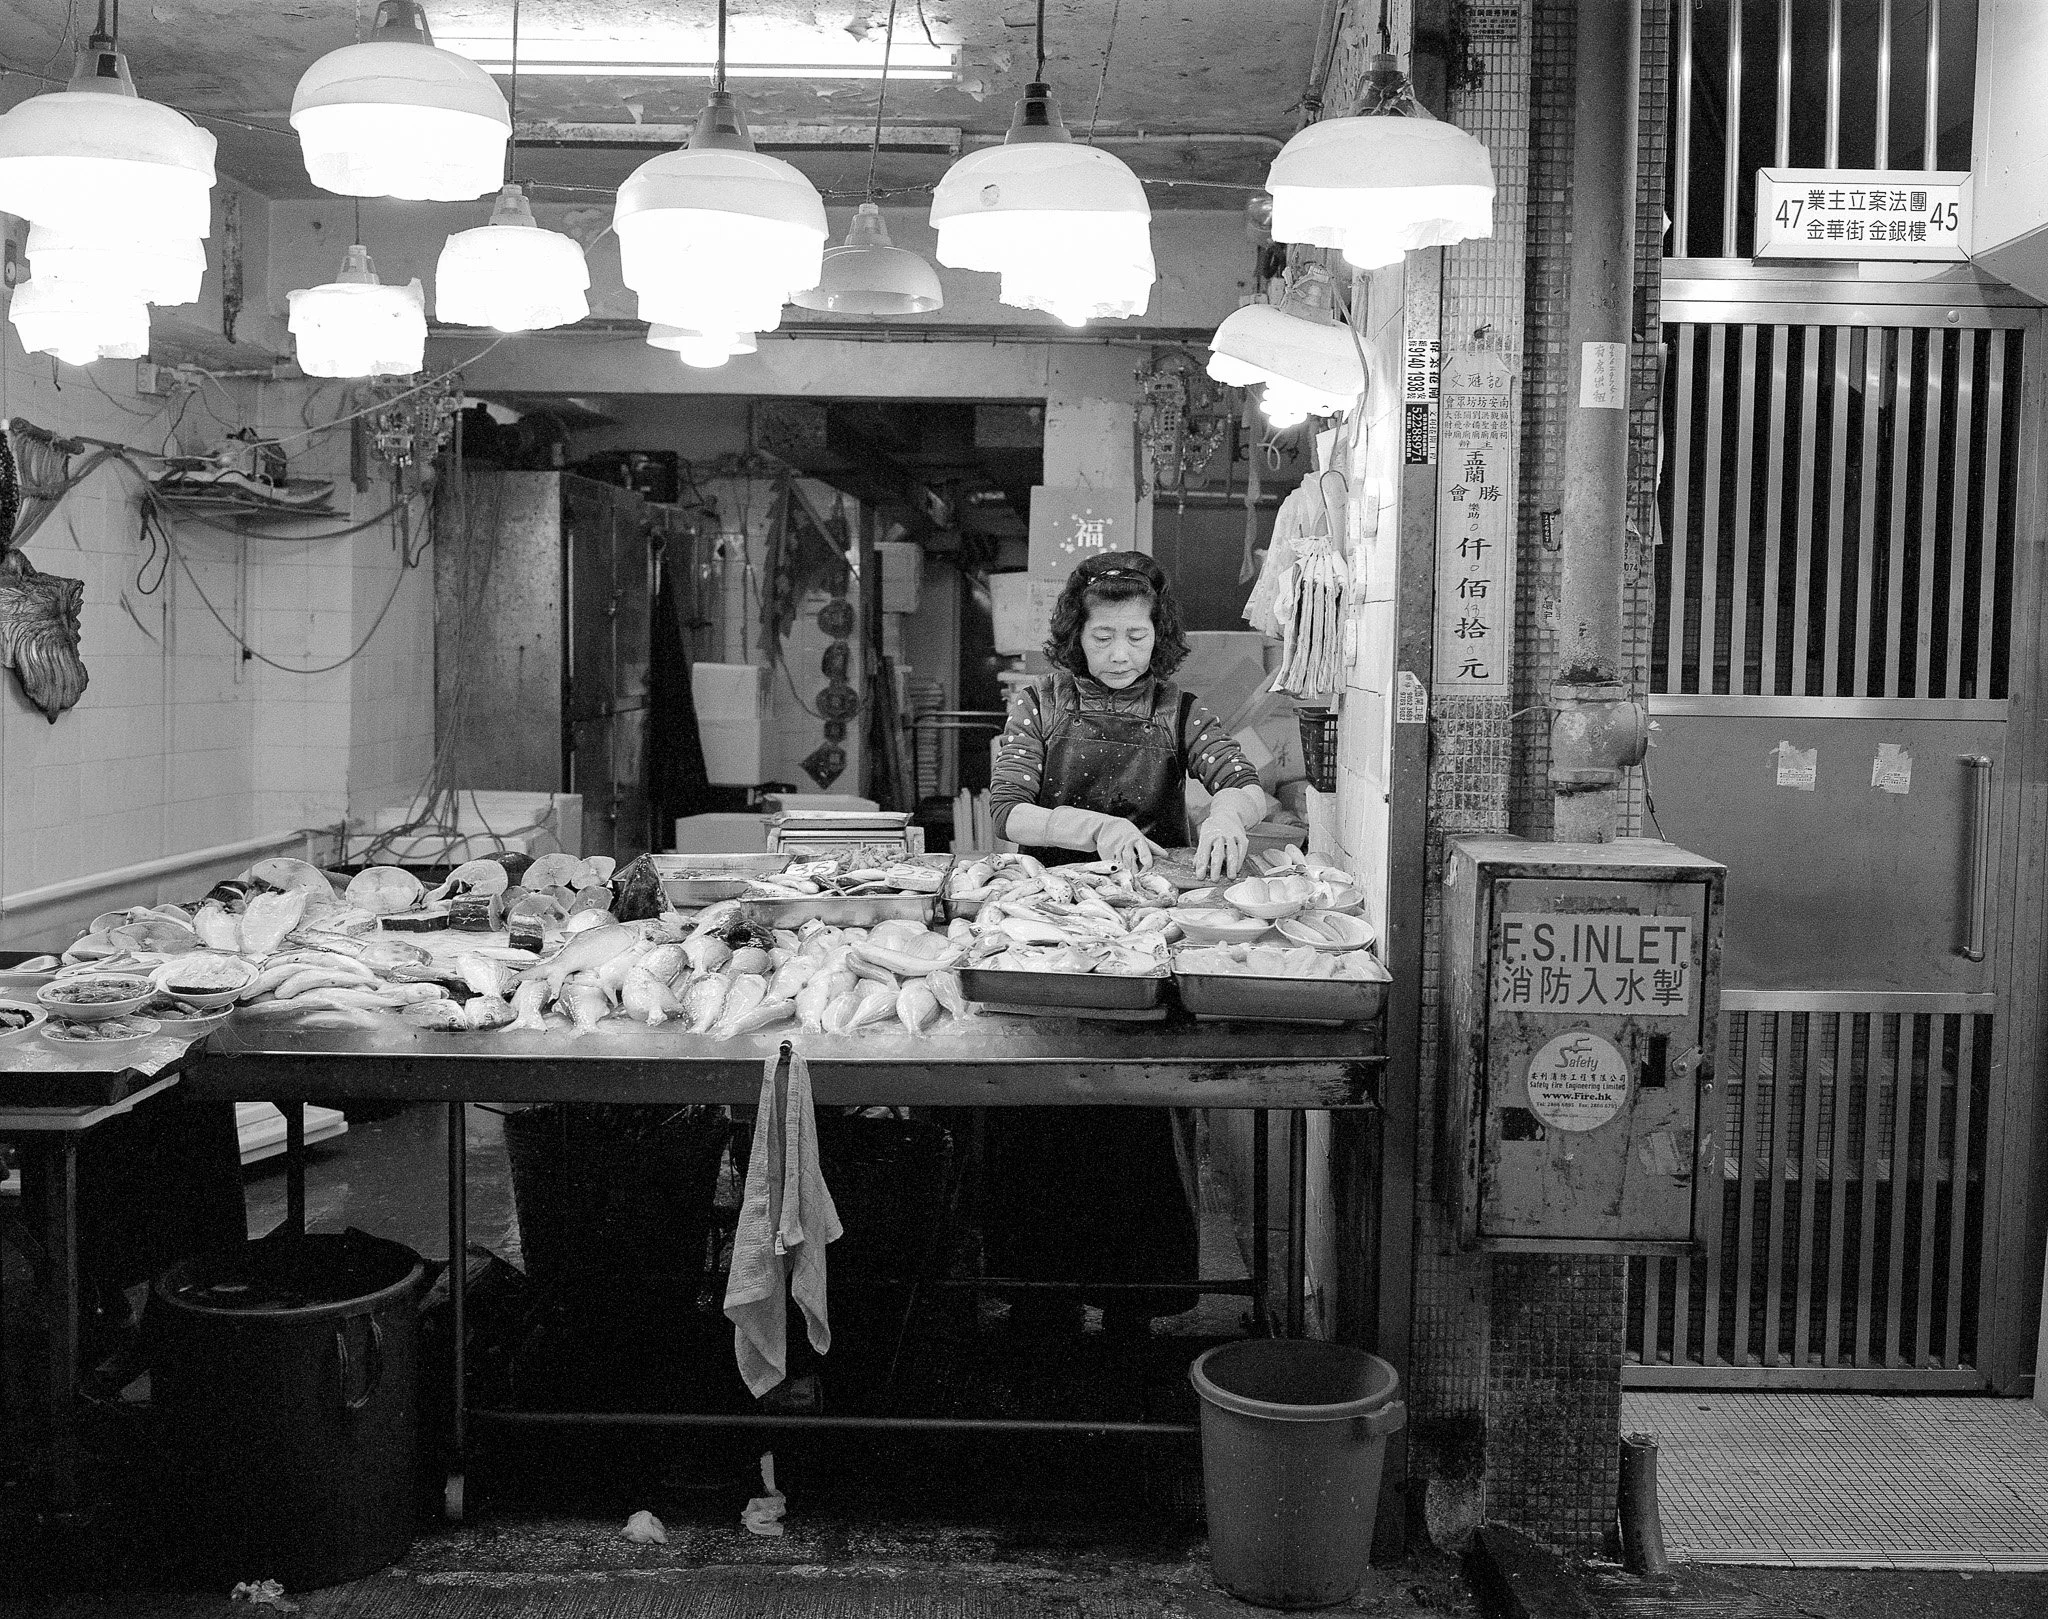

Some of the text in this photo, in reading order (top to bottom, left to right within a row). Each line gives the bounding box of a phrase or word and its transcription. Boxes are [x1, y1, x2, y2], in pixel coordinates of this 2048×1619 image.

[1775, 199, 1804, 229] 47
[1807, 189, 1927, 212] 業主立案法團
[1806, 218, 1927, 242] 金華街 金銀樓
[1929, 202, 1959, 231] 45
[1407, 347, 1426, 392] 9140 1938
[1411, 406, 1423, 463] 52288971
[1075, 519, 1105, 548] 福
[1501, 965, 1684, 1007] 消防入水掣
[1554, 1037, 1599, 1072] Safety
[1529, 1081, 1626, 1091] Safety Fire Engineering Limited
[1542, 1092, 1612, 1101] www.Fire.hk
